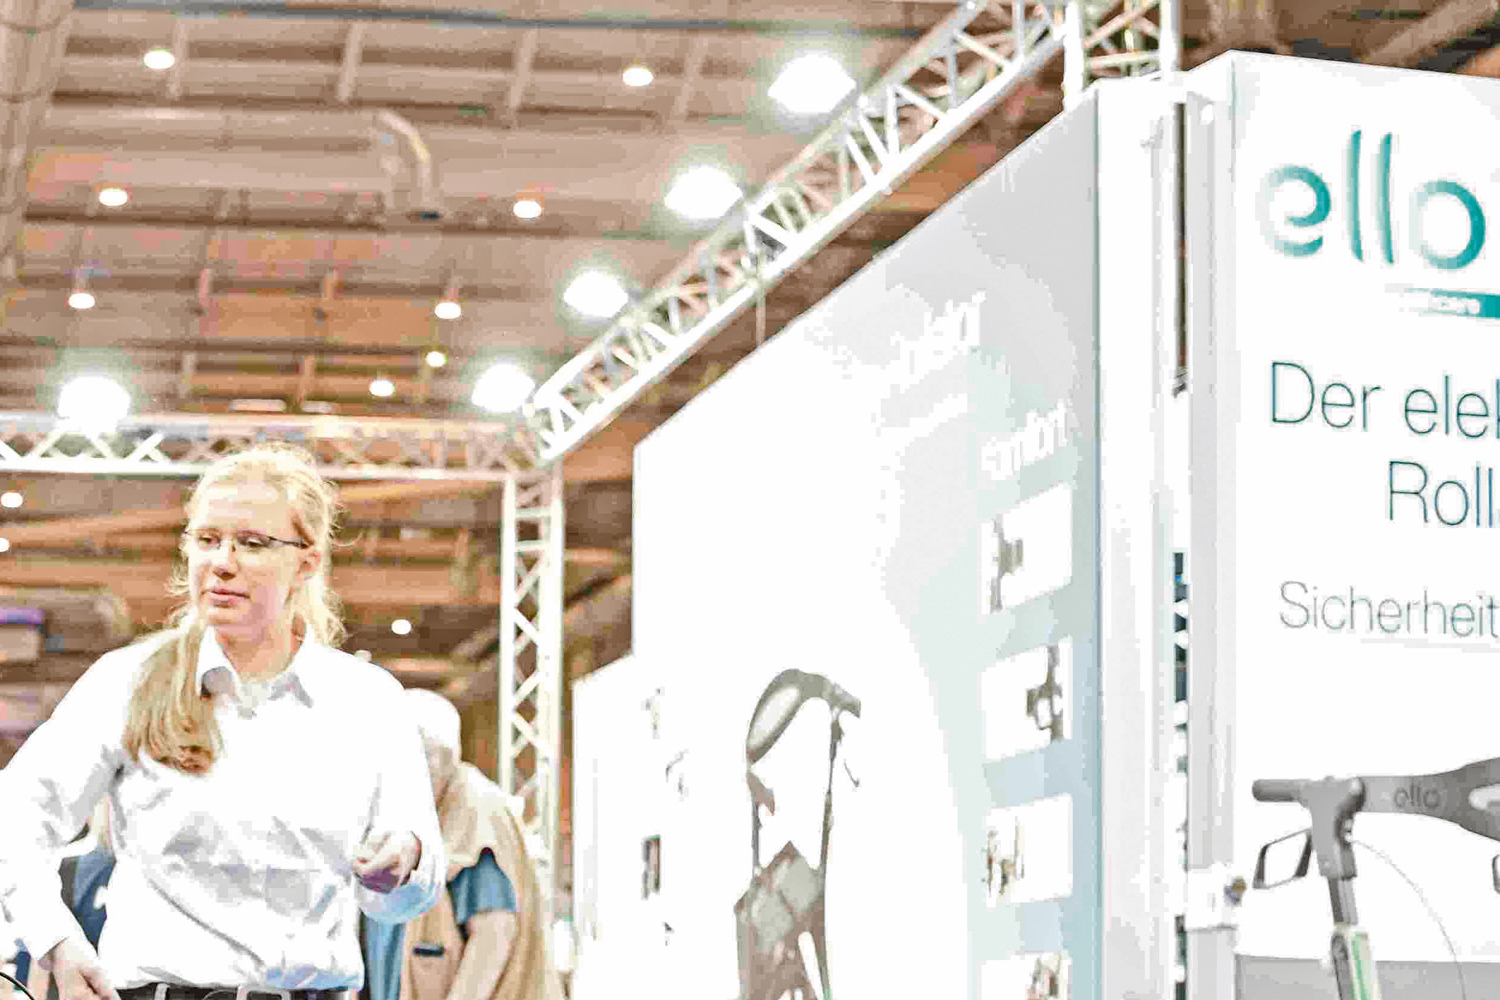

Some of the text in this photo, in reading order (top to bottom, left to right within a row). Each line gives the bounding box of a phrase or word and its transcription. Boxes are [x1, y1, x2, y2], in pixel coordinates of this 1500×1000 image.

[1260, 129, 1486, 272] ello
[1271, 361, 1500, 439] Der ele
[1389, 461, 1500, 528] Roll
[1280, 581, 1500, 638] Sicherheit
[1394, 781, 1440, 809] ello
